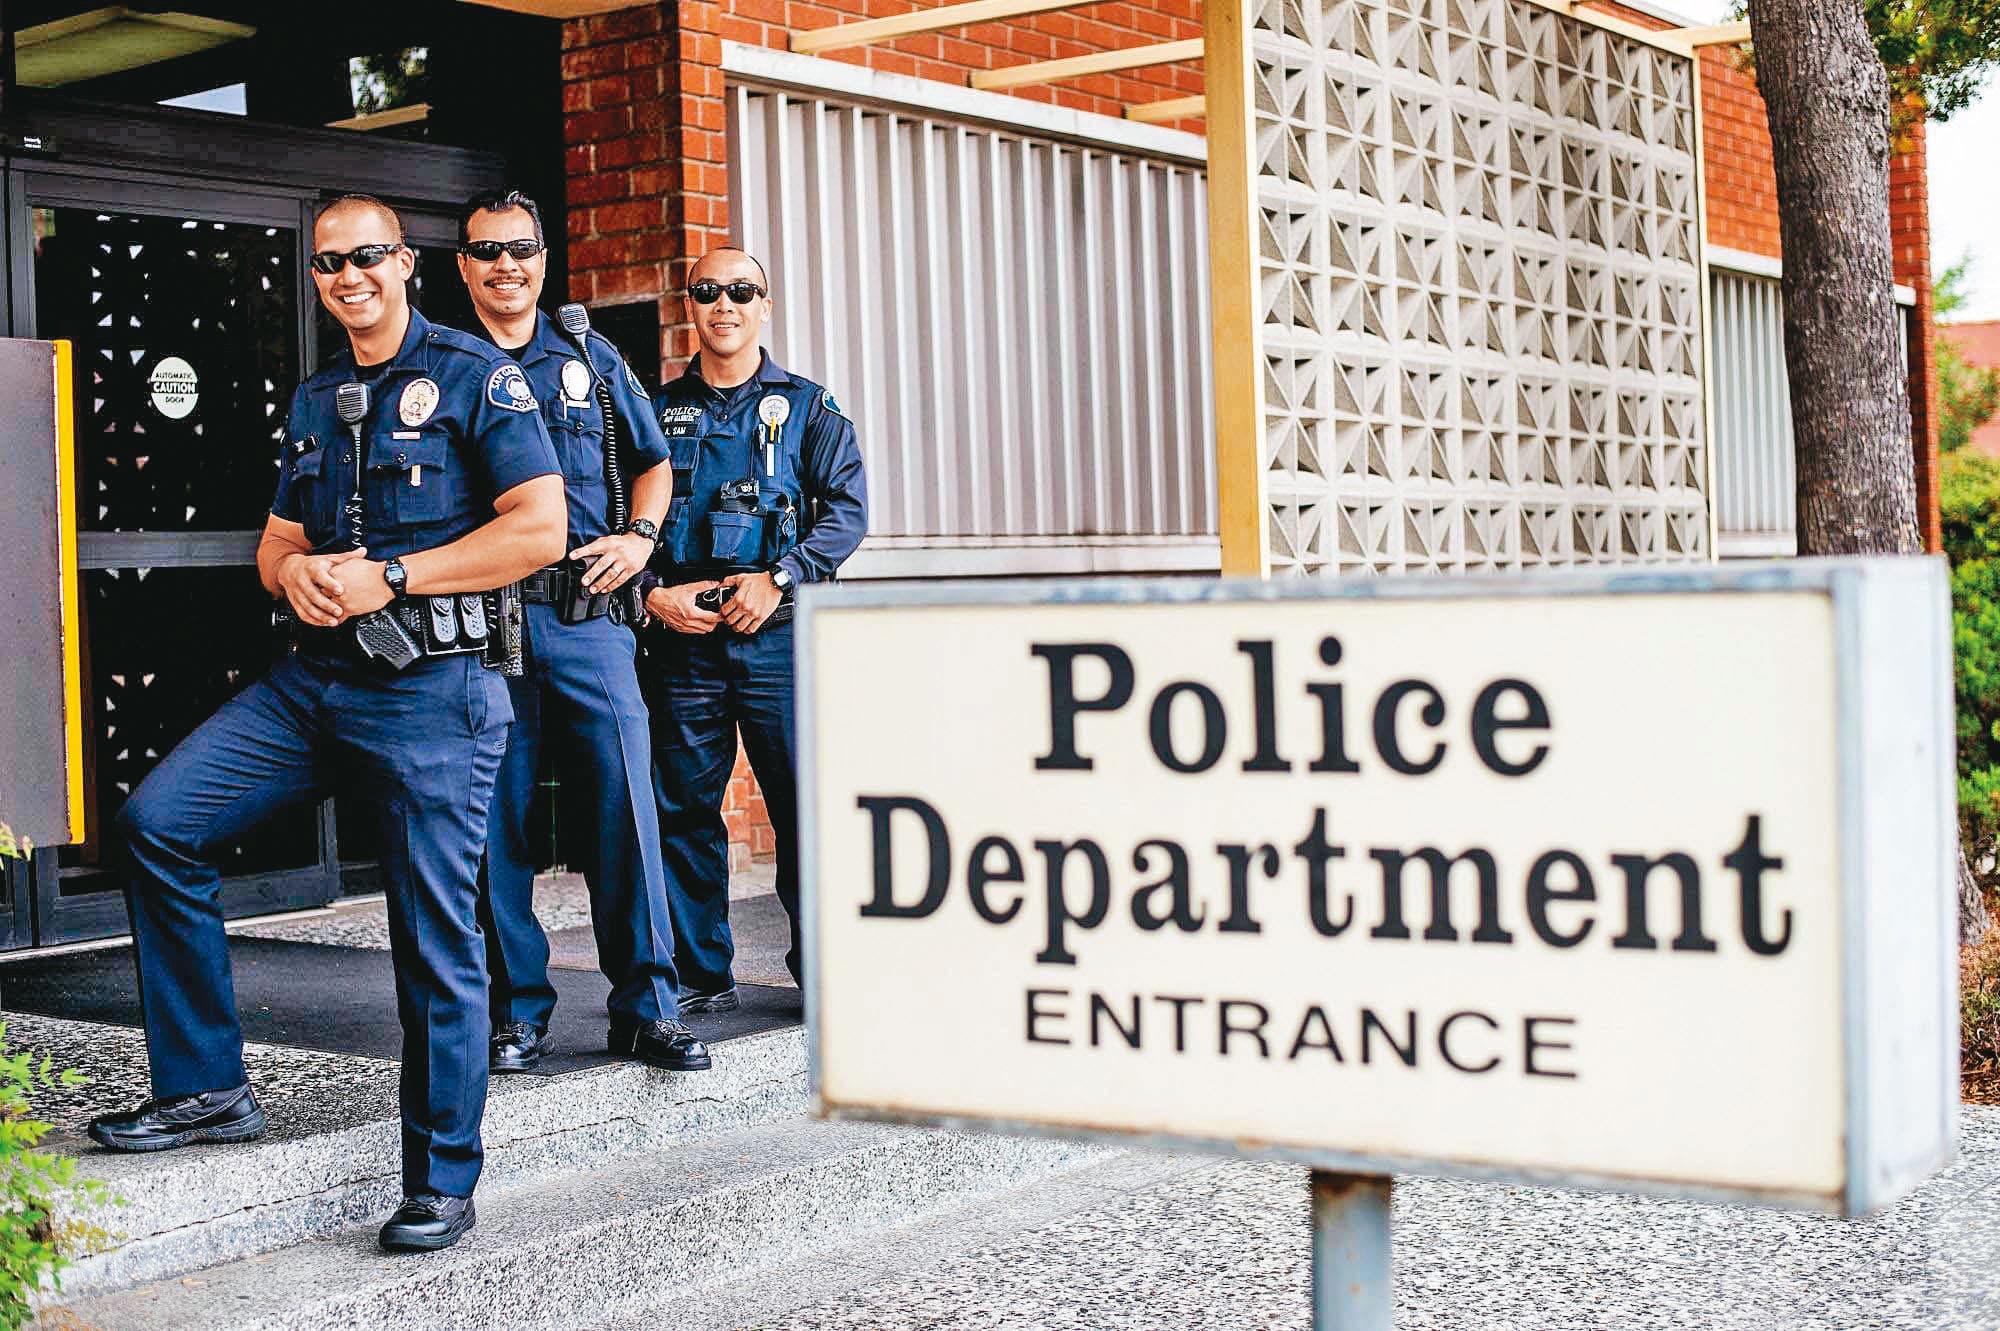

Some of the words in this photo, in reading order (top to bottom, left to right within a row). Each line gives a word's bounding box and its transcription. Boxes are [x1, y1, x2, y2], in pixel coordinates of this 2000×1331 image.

[153, 381, 196, 393] CAUTION
[662, 406, 703, 417] POLICE
[1029, 635, 1553, 778] Police
[855, 795, 1794, 967] Department
[1025, 988, 1578, 1080] ENTRANCE
